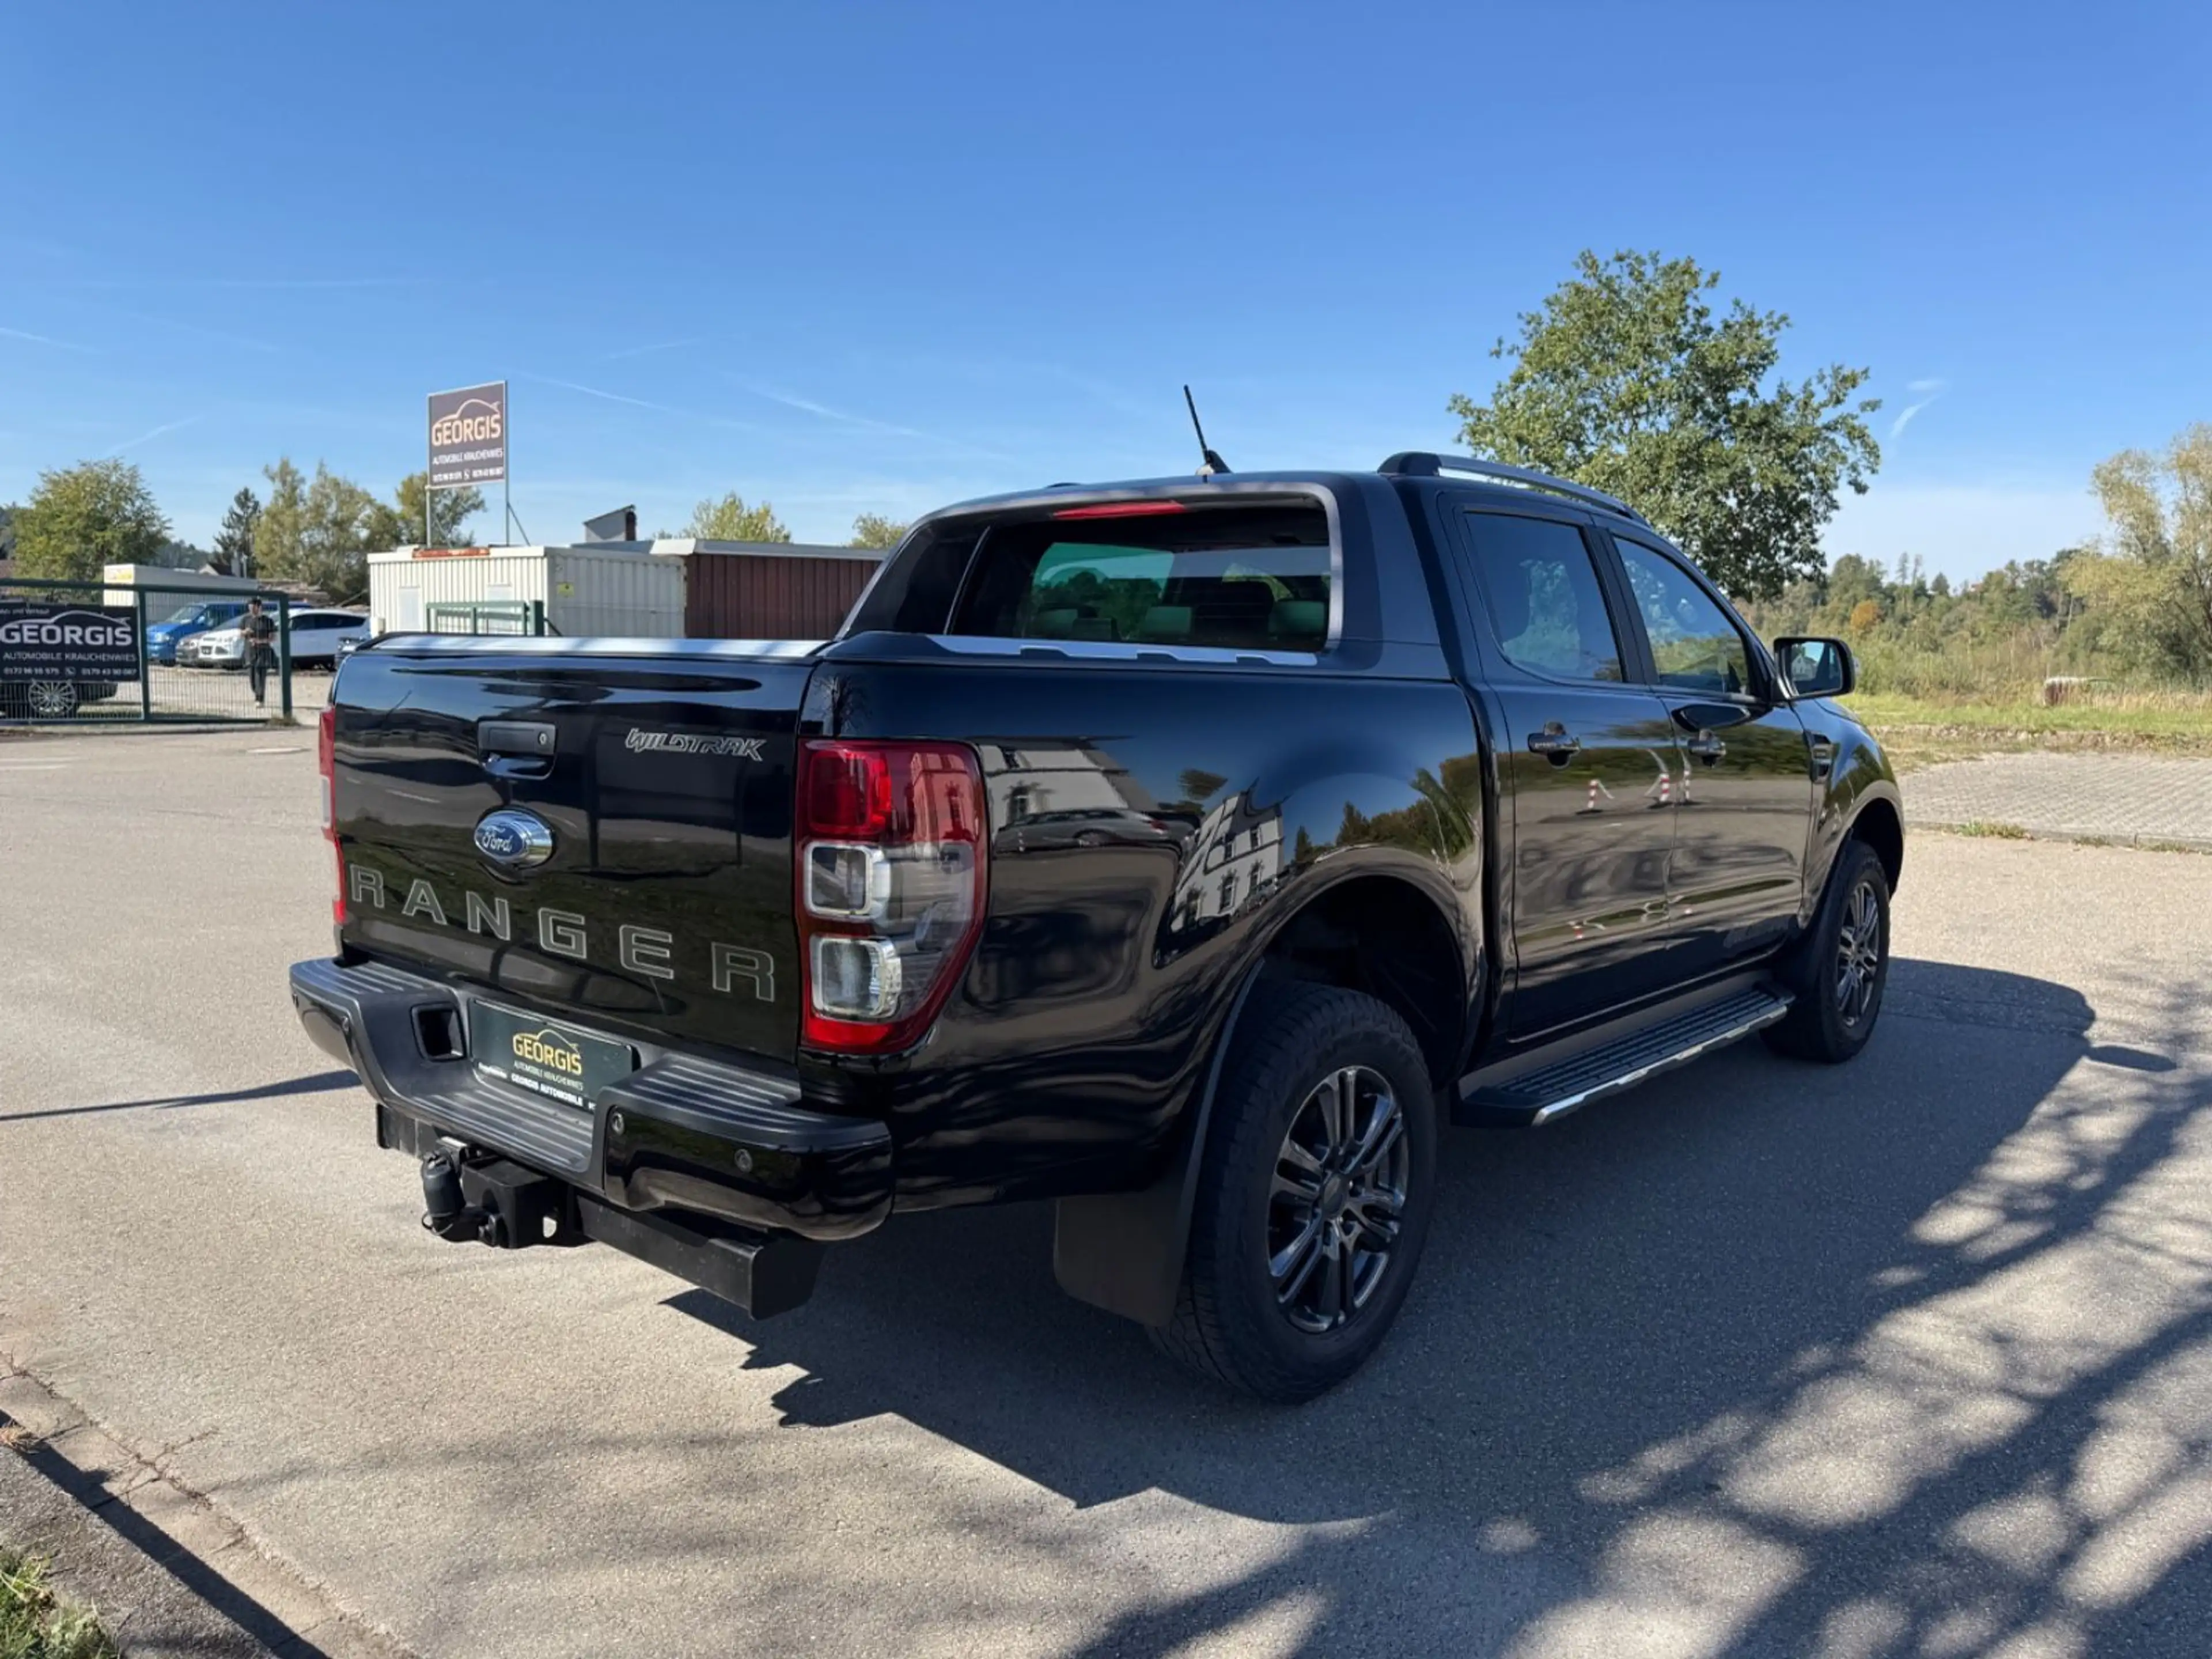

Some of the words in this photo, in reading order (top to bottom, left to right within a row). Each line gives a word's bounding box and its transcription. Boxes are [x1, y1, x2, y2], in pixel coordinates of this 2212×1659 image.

[431, 414, 501, 446] GEORGIS
[0, 624, 132, 645] GEORGIS
[2, 652, 62, 661] AUTOMOBILE
[625, 728, 767, 762] WILDTRAK
[482, 825, 514, 853] Ford
[350, 864, 775, 1002] RANGER
[513, 1035, 582, 1076] GEORGIS
